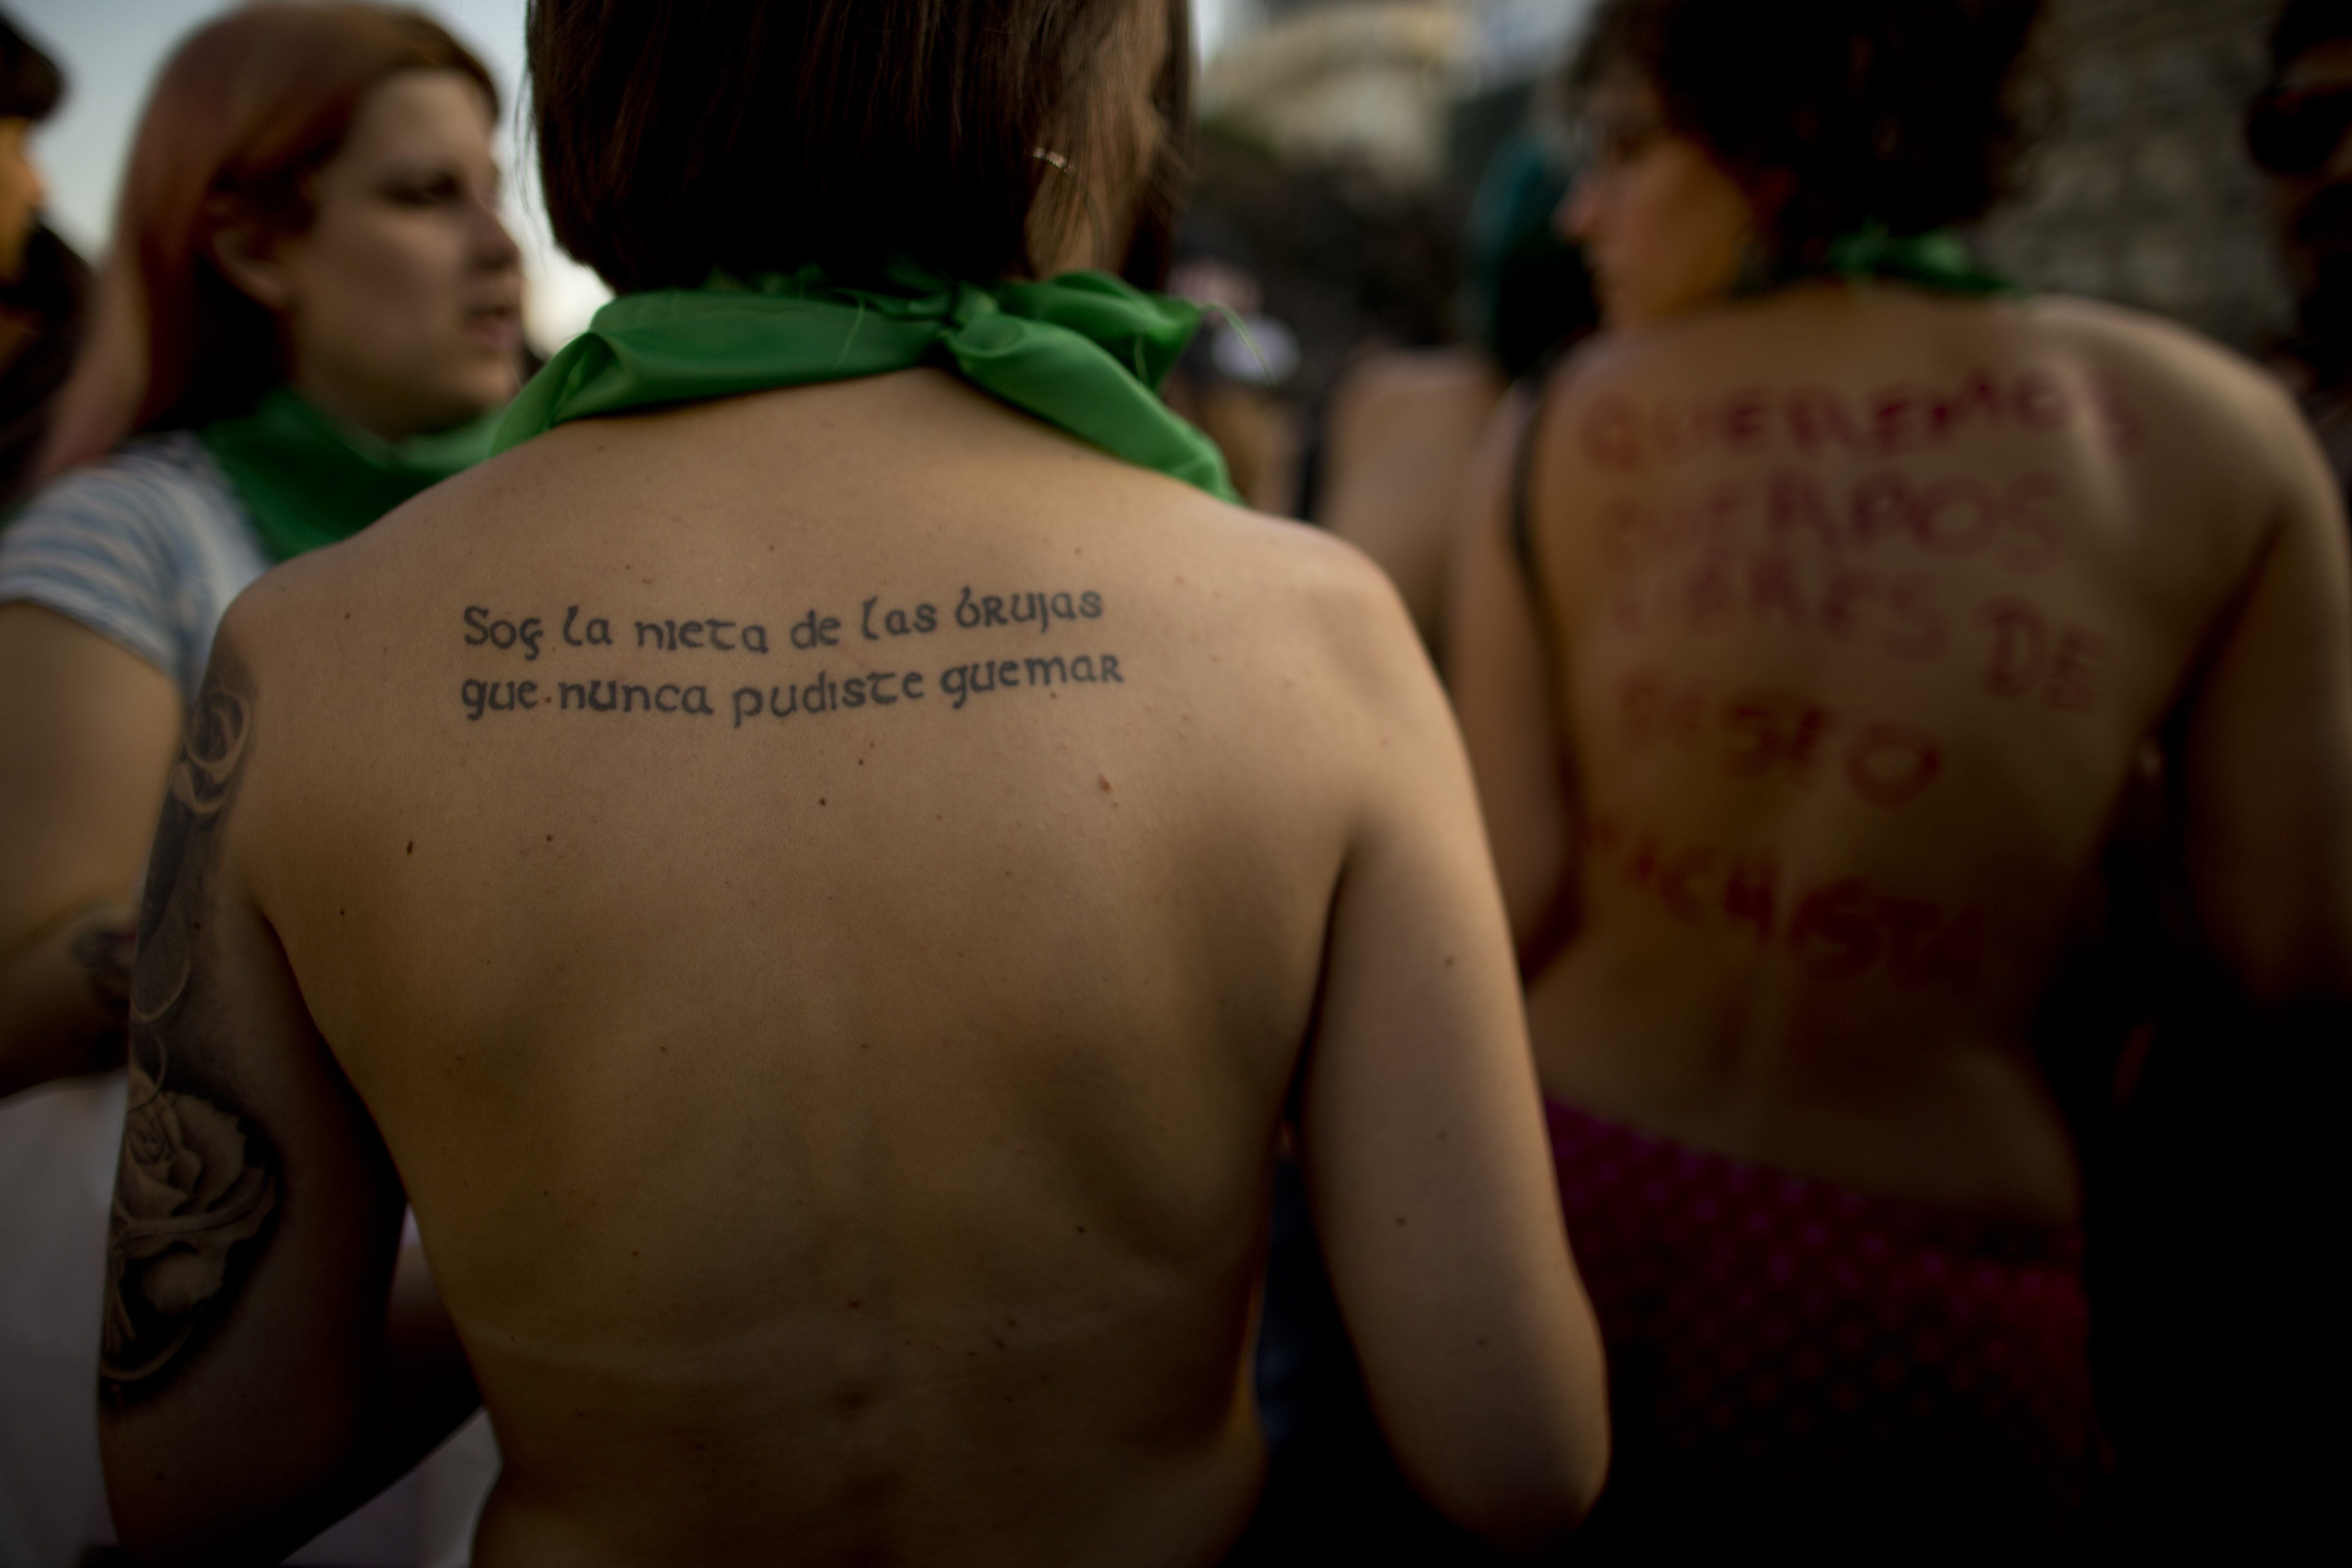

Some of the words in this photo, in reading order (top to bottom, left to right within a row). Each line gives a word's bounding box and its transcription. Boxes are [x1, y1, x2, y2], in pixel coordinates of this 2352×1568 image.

[561, 604, 613, 647] la
[633, 617, 769, 655] nieta
[789, 608, 842, 651] de
[861, 595, 938, 641] las
[1971, 594, 2107, 715] DE
[557, 679, 715, 716] nunca
[731, 670, 925, 730] pudiste
